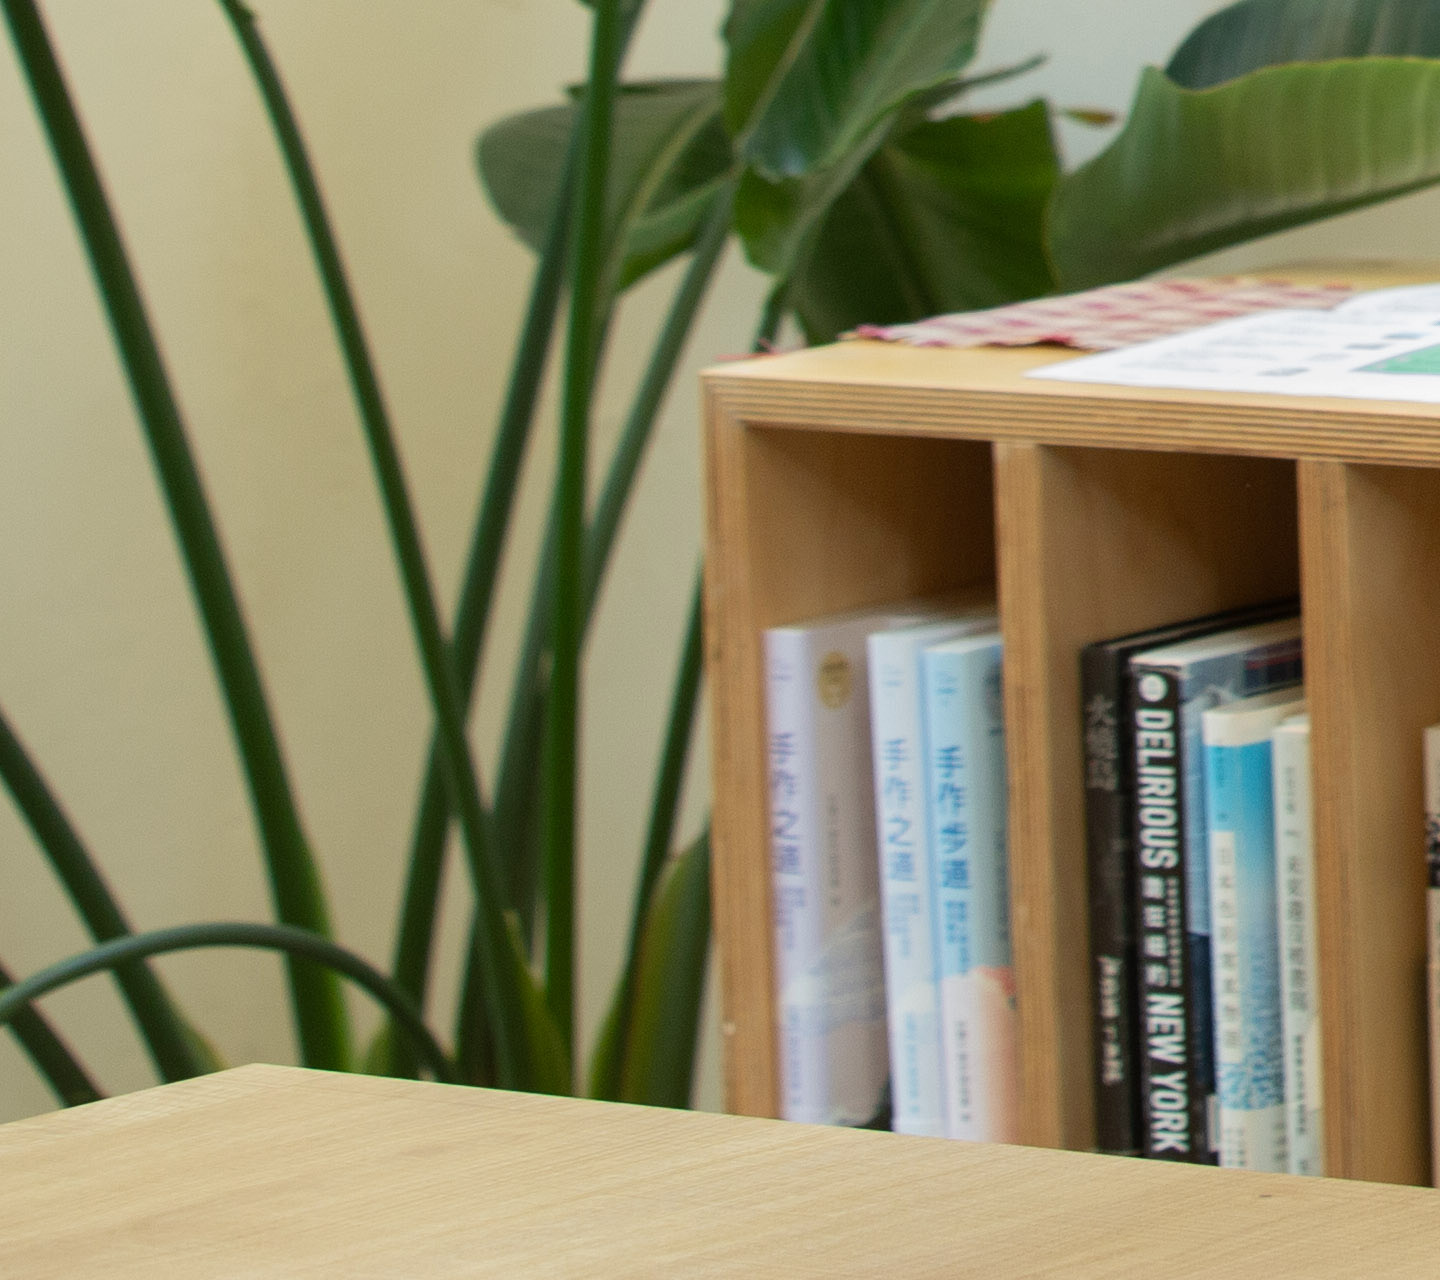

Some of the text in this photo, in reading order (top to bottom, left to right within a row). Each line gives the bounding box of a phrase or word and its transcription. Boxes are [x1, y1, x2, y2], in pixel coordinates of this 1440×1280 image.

[1135, 708, 1179, 869] DELIRIOUS
[1146, 993, 1187, 1064] NEW
[1150, 1070, 1190, 1153] YORK
